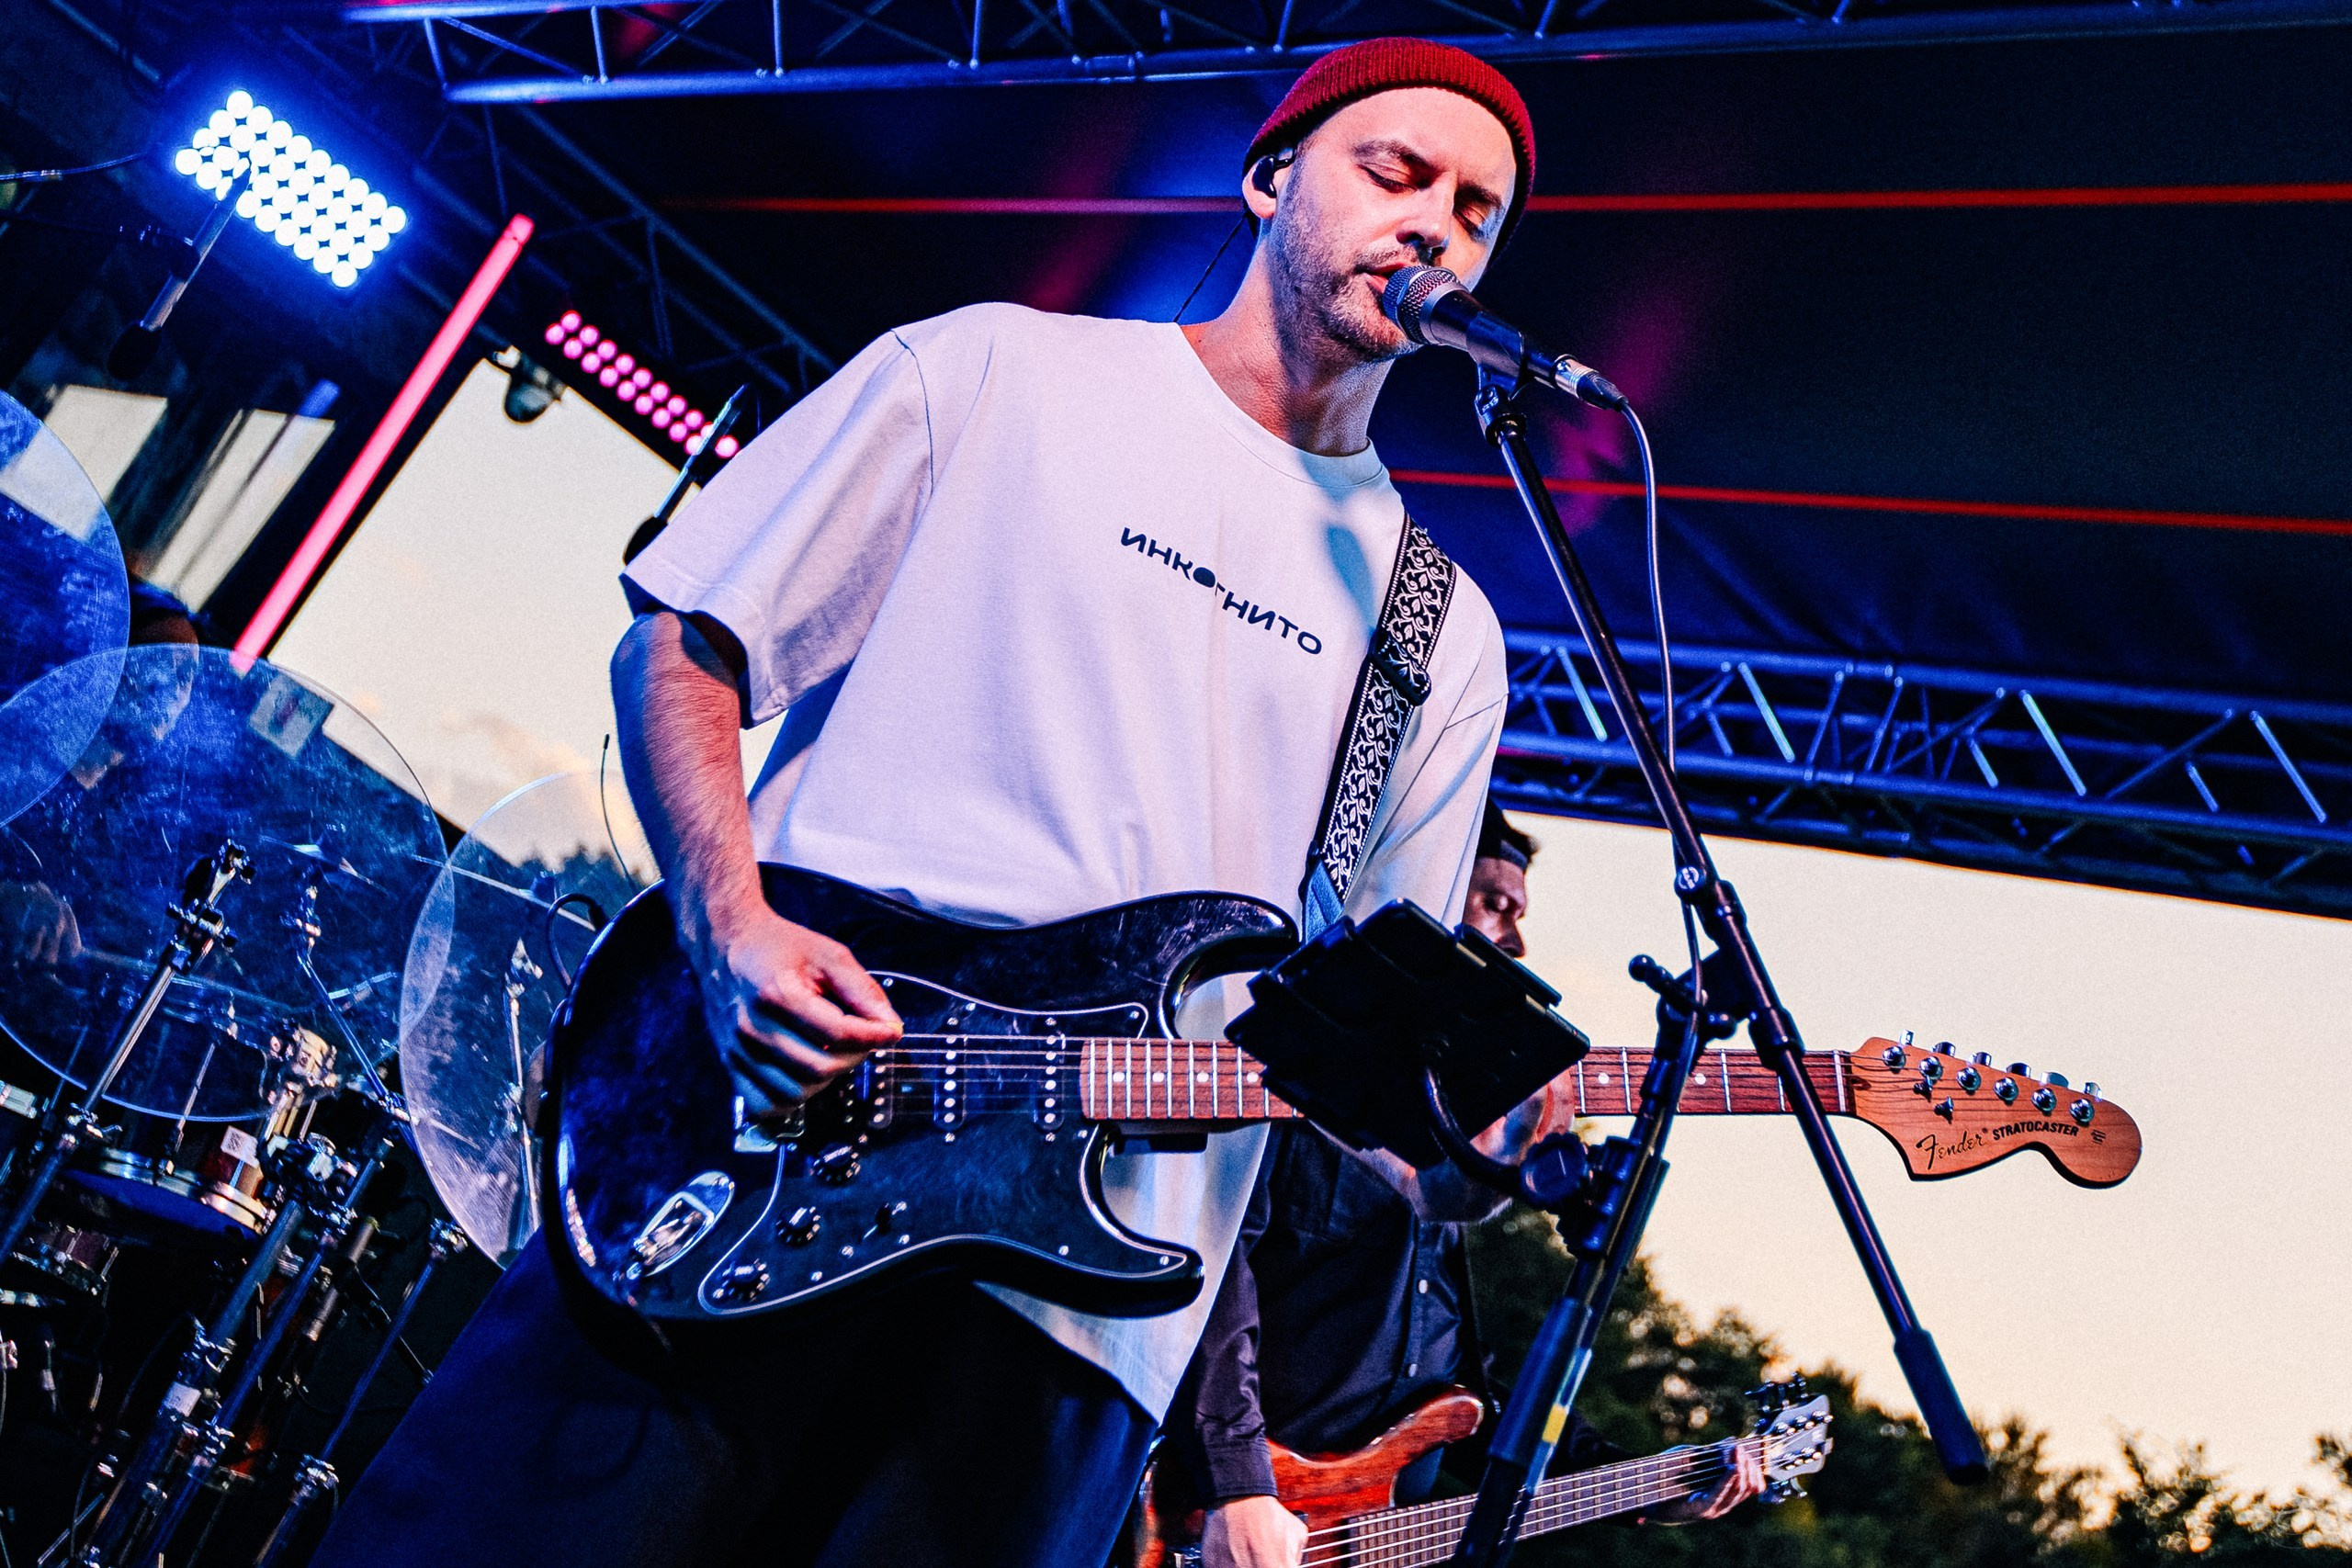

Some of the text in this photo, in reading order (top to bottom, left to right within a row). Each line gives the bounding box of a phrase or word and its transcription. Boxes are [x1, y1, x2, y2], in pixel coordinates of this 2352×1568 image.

[1121, 527, 1322, 655] ИНКОГНИТО
[1916, 1130, 1988, 1169] Fender
[1992, 1121, 2079, 1141] STRATOCASTER
